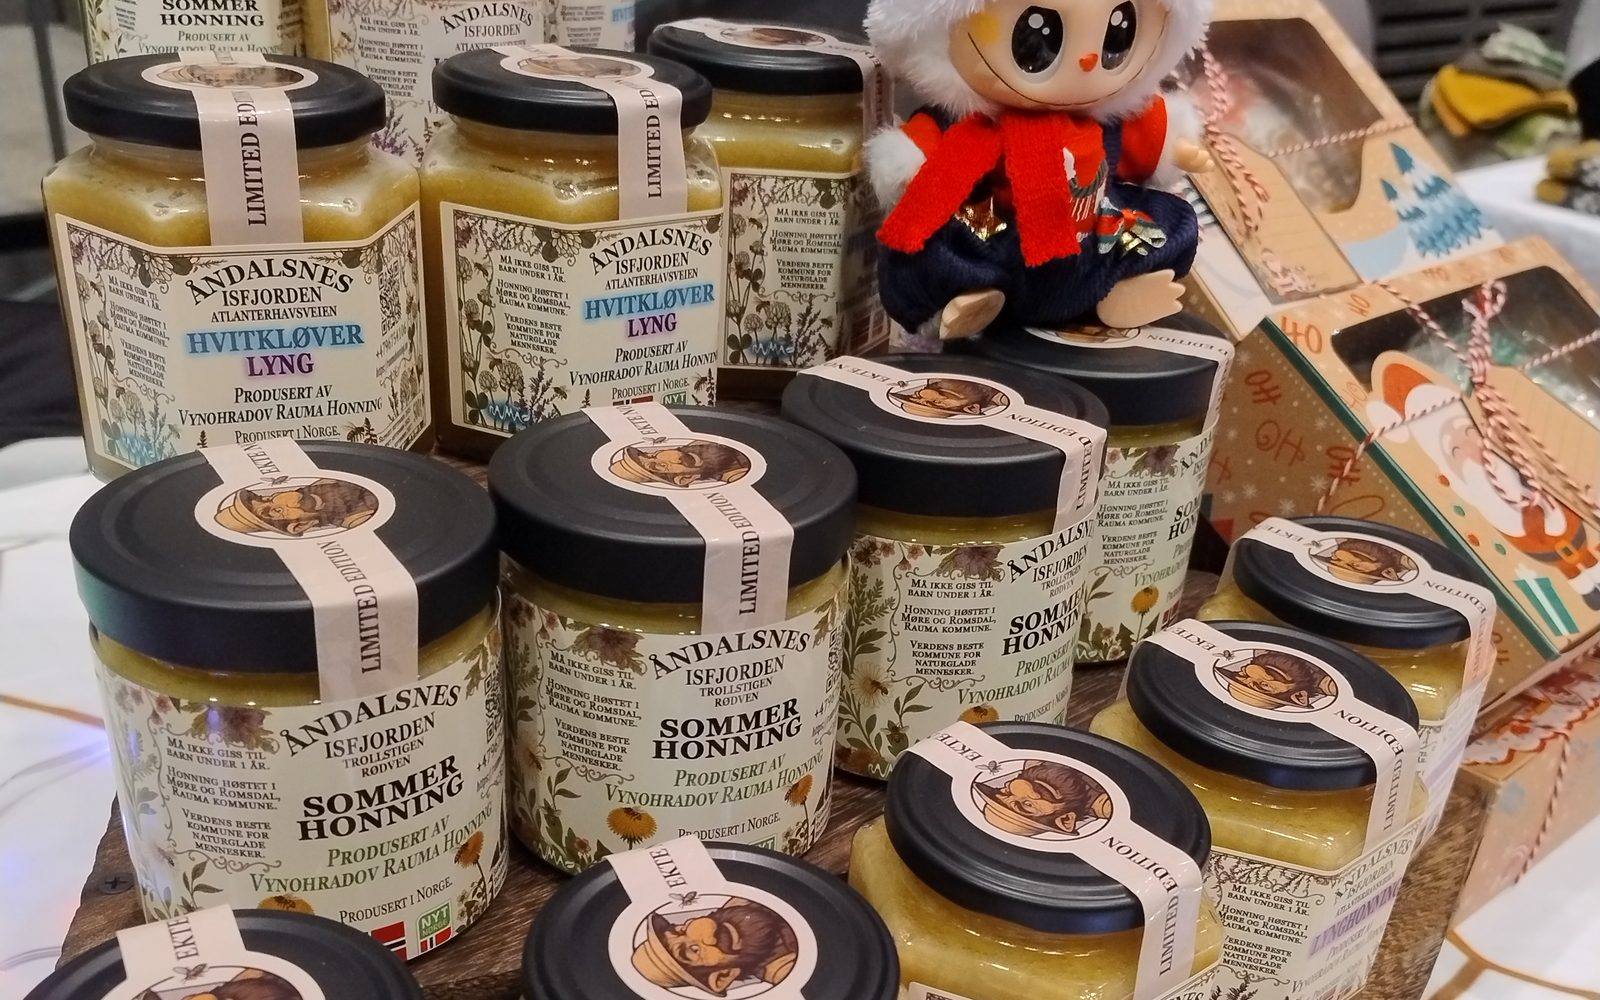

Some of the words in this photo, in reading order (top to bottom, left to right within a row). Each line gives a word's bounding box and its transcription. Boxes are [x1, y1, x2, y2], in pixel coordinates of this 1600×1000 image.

[162, 0, 259, 11] SOMMER
[440, 2, 534, 34] ÅNDALSNES
[160, 14, 265, 27] HONNING
[464, 23, 522, 38] ISFJORDEN
[178, 30, 236, 41] PRODUSERT
[647, 115, 662, 199] LIMITED
[240, 132, 267, 226] LIMITED
[589, 228, 713, 276] ÅNDALSNES
[615, 251, 690, 275] ISFJORDEN
[185, 258, 354, 306] ÅNDALSNES
[605, 268, 699, 290] ATLANTERHAVSVEIEN
[221, 286, 323, 307] ISFJORDEN
[585, 283, 715, 320] HVITKLØVER
[210, 305, 338, 323] ATLANTERHAVSVEIEN
[504, 312, 538, 327] VERDENS
[627, 313, 678, 338] LYNG
[186, 324, 365, 354] HVITKLØVER
[506, 323, 544, 337] KOMMUNE
[509, 331, 558, 347] NATURGLADE
[615, 344, 673, 363] PRODUSERT
[674, 340, 689, 354] AV
[245, 352, 315, 377] LYNG
[569, 368, 642, 386] VYNOHRADOV
[645, 359, 679, 376] RAUMA
[233, 386, 311, 404] PRODUSERT
[315, 385, 333, 398] AV
[611, 386, 657, 400] PRODUSERT
[662, 377, 690, 392] NORGE.
[178, 407, 273, 427] VYNOHRADOV
[276, 404, 323, 421] RAUMA
[327, 397, 382, 417] HONNING
[234, 429, 295, 444] PRODUSERT
[302, 425, 341, 439] NORGE.
[1005, 413, 1077, 437] EDITION
[703, 492, 753, 529] EDITION
[317, 540, 367, 583] EDITION
[738, 530, 760, 616] LIMITED
[908, 589, 934, 598] BARN
[936, 591, 969, 599] UNDER
[911, 578, 928, 589] MÅ
[930, 581, 953, 590] IKKE
[956, 581, 976, 590] GISS
[979, 581, 994, 589] TIL
[1423, 580, 1487, 614] EDITION
[901, 613, 930, 624] MØRE
[932, 617, 946, 625] OG
[949, 616, 997, 625] ROMSDAL,
[904, 604, 950, 616] HONNING
[954, 607, 989, 616] HØSTET
[1009, 586, 1084, 636] SOMME
[353, 584, 381, 674] LIMITED
[903, 622, 939, 633] RAUMA
[941, 624, 992, 633] KOMMUNE.
[1172, 627, 1217, 651] EKTE
[648, 629, 811, 680] ÅNDALSNES
[910, 640, 954, 650] VERDENS
[956, 642, 984, 650] BESTE
[912, 651, 960, 659] KOMMUNE
[963, 651, 981, 659] FOR
[685, 655, 786, 686] ISFJORDEN
[915, 659, 977, 667] NATURGLADE
[915, 667, 974, 675] MENNESKER.
[699, 676, 773, 697] TROLLSTIGEN
[958, 676, 1042, 704] VYNOHRADOV
[714, 691, 760, 708] RØDVEN
[279, 684, 461, 757] ÅNDALSNES
[554, 717, 598, 739] VERDENS
[599, 735, 631, 745] BESTE
[660, 698, 800, 740] SOMMER
[324, 711, 436, 759] ISFJORDEN
[557, 729, 605, 750] KOMMUNE
[607, 744, 628, 754] FOR
[651, 716, 803, 760] HONNING
[1334, 709, 1405, 756] EDITION
[343, 738, 425, 769] TROLLSTIGEN
[561, 739, 623, 763] NATURGLADE
[562, 749, 622, 771] MENNESKER.
[937, 733, 983, 762] EKTE
[361, 754, 412, 778] RØDVEN
[674, 760, 766, 787] PRODUSERT
[767, 753, 787, 772] AV
[303, 755, 459, 818] SOMMER
[605, 783, 719, 808] VYNOHRADOV
[720, 779, 774, 804] RAUMA
[182, 807, 232, 828] VERDENS
[235, 820, 272, 831] BESTE
[297, 773, 465, 841] HONNING
[187, 821, 244, 839] KOMMUNE
[245, 830, 270, 840] FOR
[748, 812, 781, 832] NORGE.
[192, 831, 267, 849] NATURGLADE
[194, 841, 266, 859] MENNESKER.
[327, 825, 430, 867] PRODUSERT
[431, 815, 450, 838] AV
[251, 866, 380, 893] VYNOHRADOV
[382, 845, 440, 879] RAUMA
[650, 846, 687, 888] EKTE
[1101, 837, 1178, 893] EDITION
[339, 895, 408, 924] PRODUSERT
[416, 876, 453, 901] NORGE.
[1232, 884, 1247, 895] MÅ
[1249, 889, 1271, 900] IKKE
[1273, 896, 1293, 905] GISS
[1295, 900, 1310, 909] TIL
[421, 905, 451, 927] NYT
[1218, 910, 1245, 924] MØRE
[1246, 919, 1260, 927] OG
[1261, 922, 1308, 939] ROMSDAL,
[1159, 895, 1179, 976] LIMITED
[1223, 943, 1268, 959] KOMMUNE
[1270, 954, 1288, 964] FOR
[1224, 951, 1282, 969] NATURGLADE
